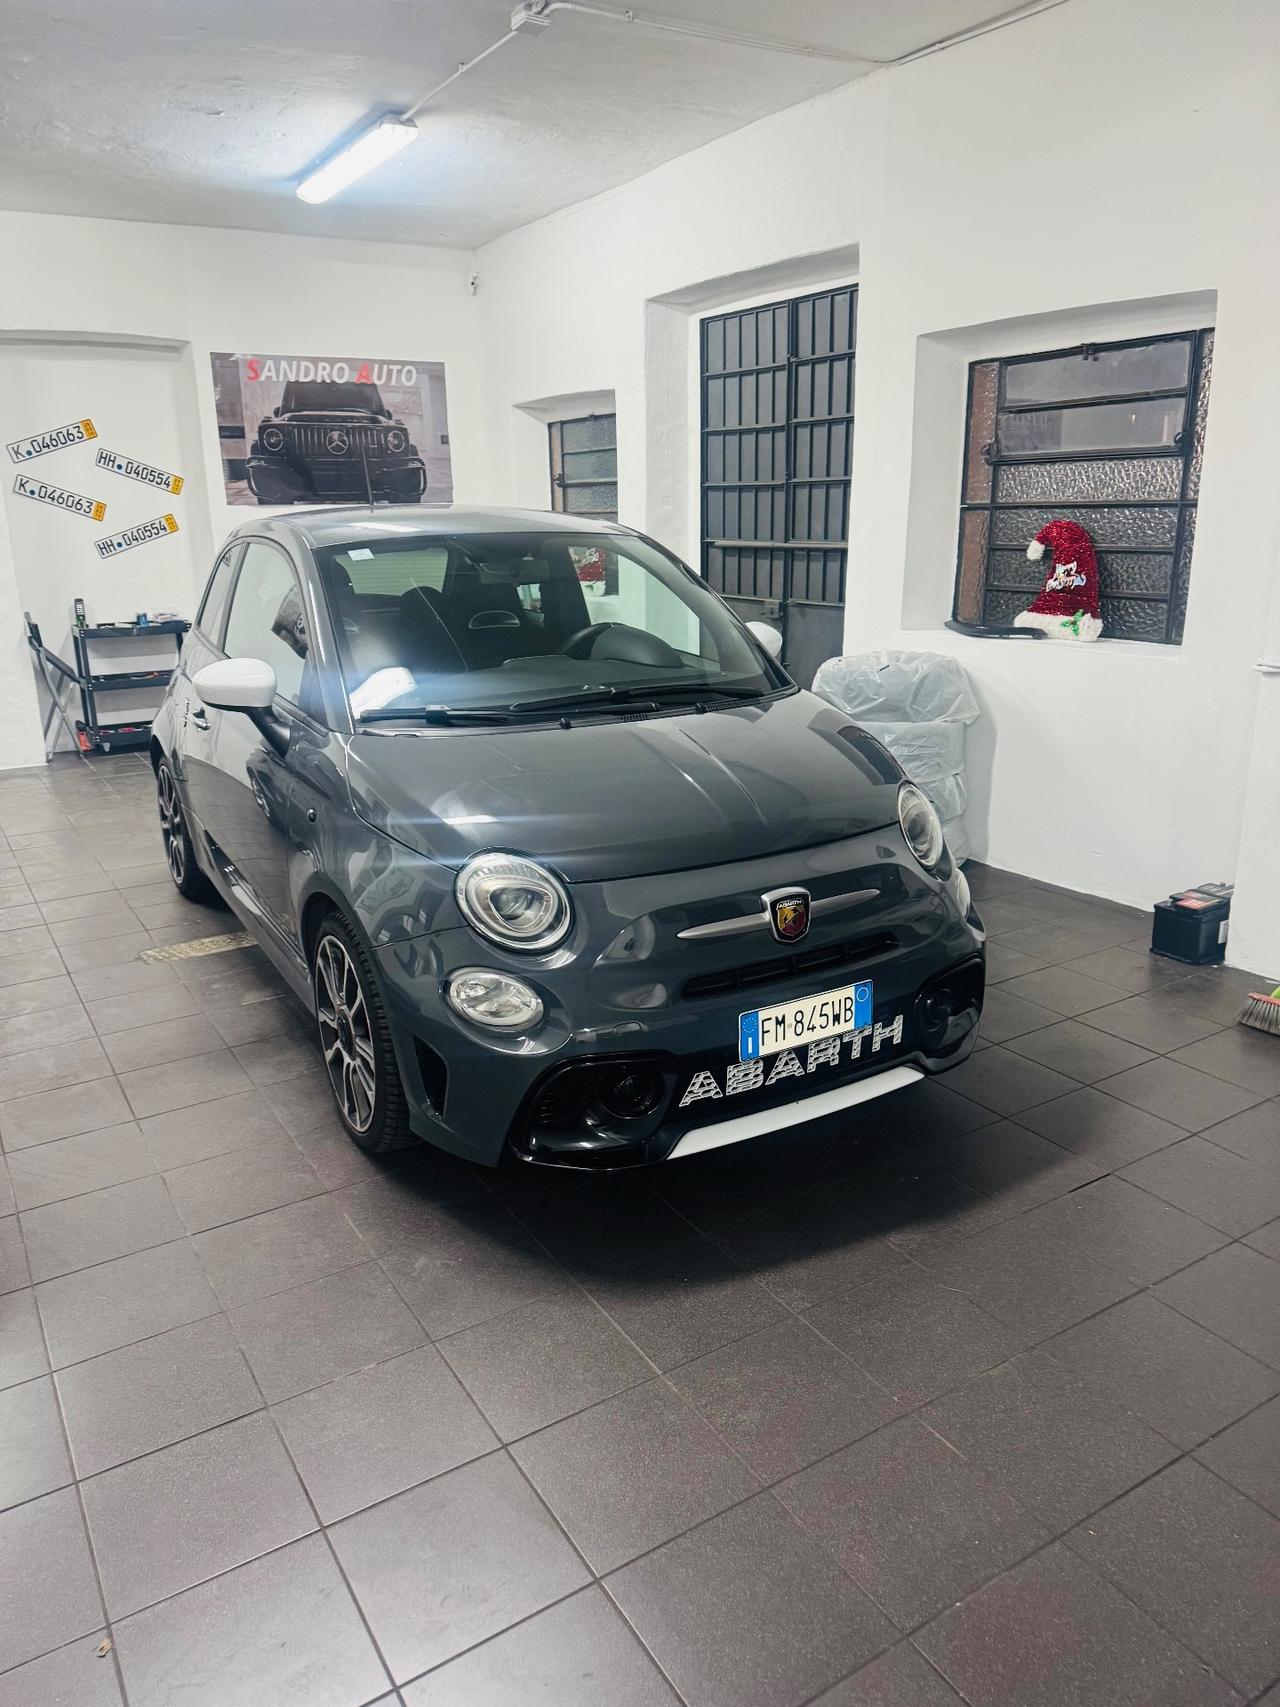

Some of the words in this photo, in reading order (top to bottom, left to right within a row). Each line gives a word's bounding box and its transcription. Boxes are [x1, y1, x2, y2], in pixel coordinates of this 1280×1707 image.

[245, 357, 350, 384] SANDRO
[355, 361, 417, 386] AUTO
[12, 444, 25, 460] K
[30, 425, 85, 455] 046063
[98, 451, 117, 469] HH
[124, 461, 171, 489] 040554
[18, 478, 30, 493] K
[38, 485, 94, 515] 046063
[97, 539, 117, 556] HH
[122, 520, 168, 547] 040554
[679, 1014, 903, 1108] ABARTH
